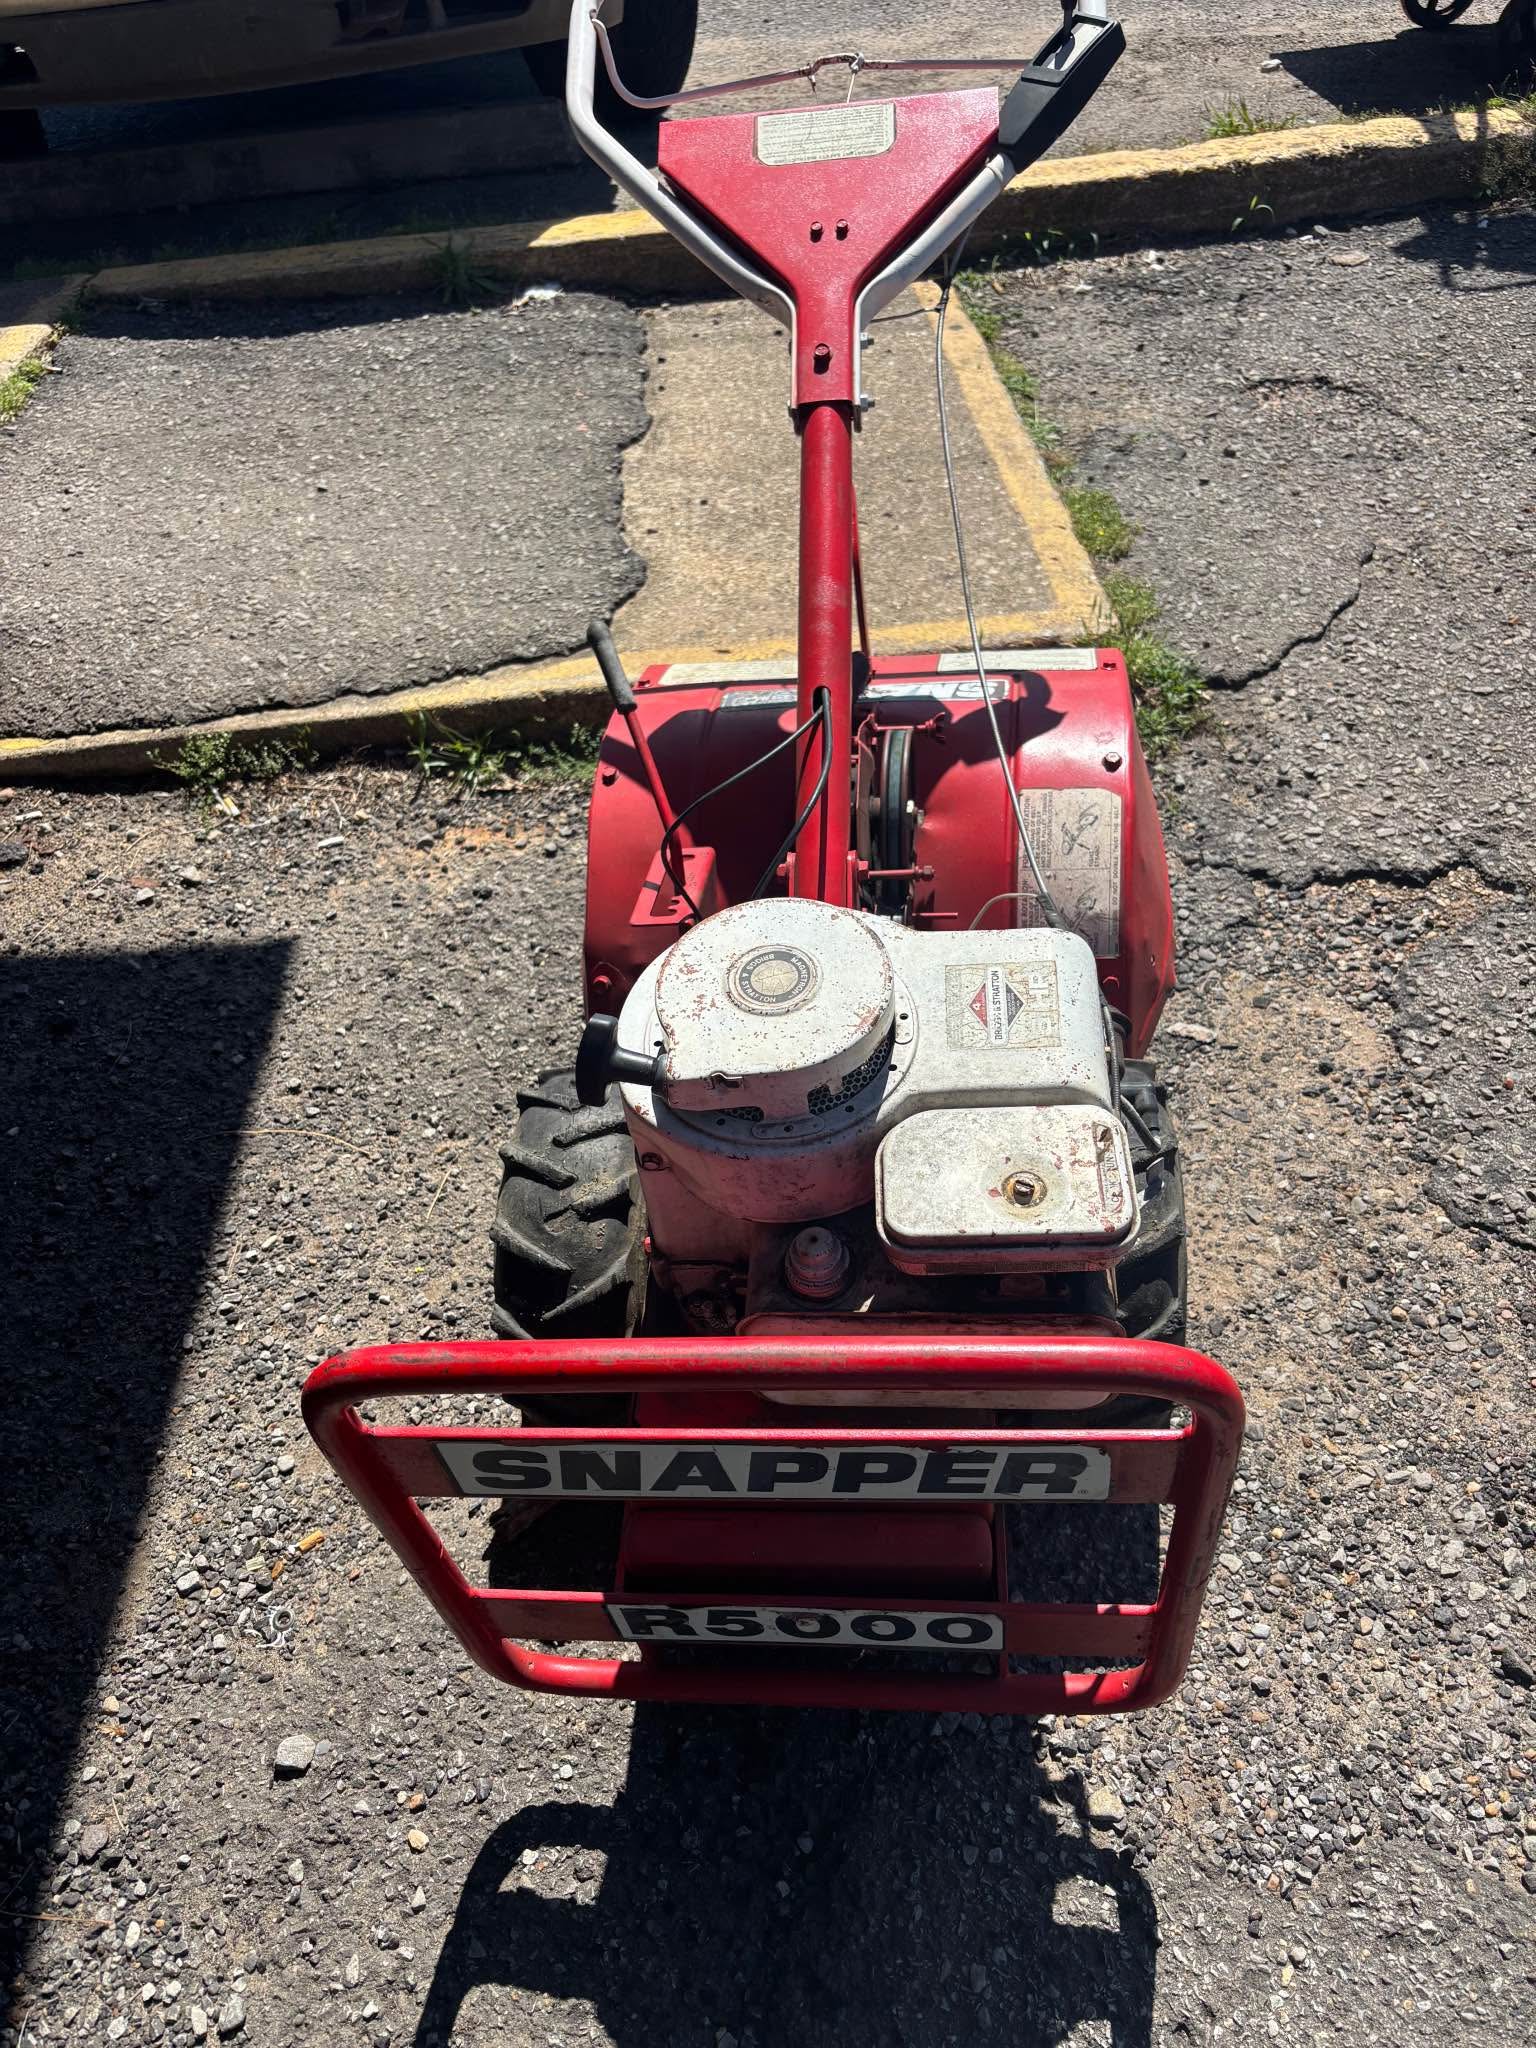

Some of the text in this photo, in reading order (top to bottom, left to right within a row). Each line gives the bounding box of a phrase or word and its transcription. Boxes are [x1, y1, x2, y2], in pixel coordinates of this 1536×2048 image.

[741, 980, 776, 1003] STRATTON
[990, 970, 1001, 1006] STRATTON
[472, 1449, 1088, 1494] SNAPPER
[620, 1607, 993, 1644] R5000
